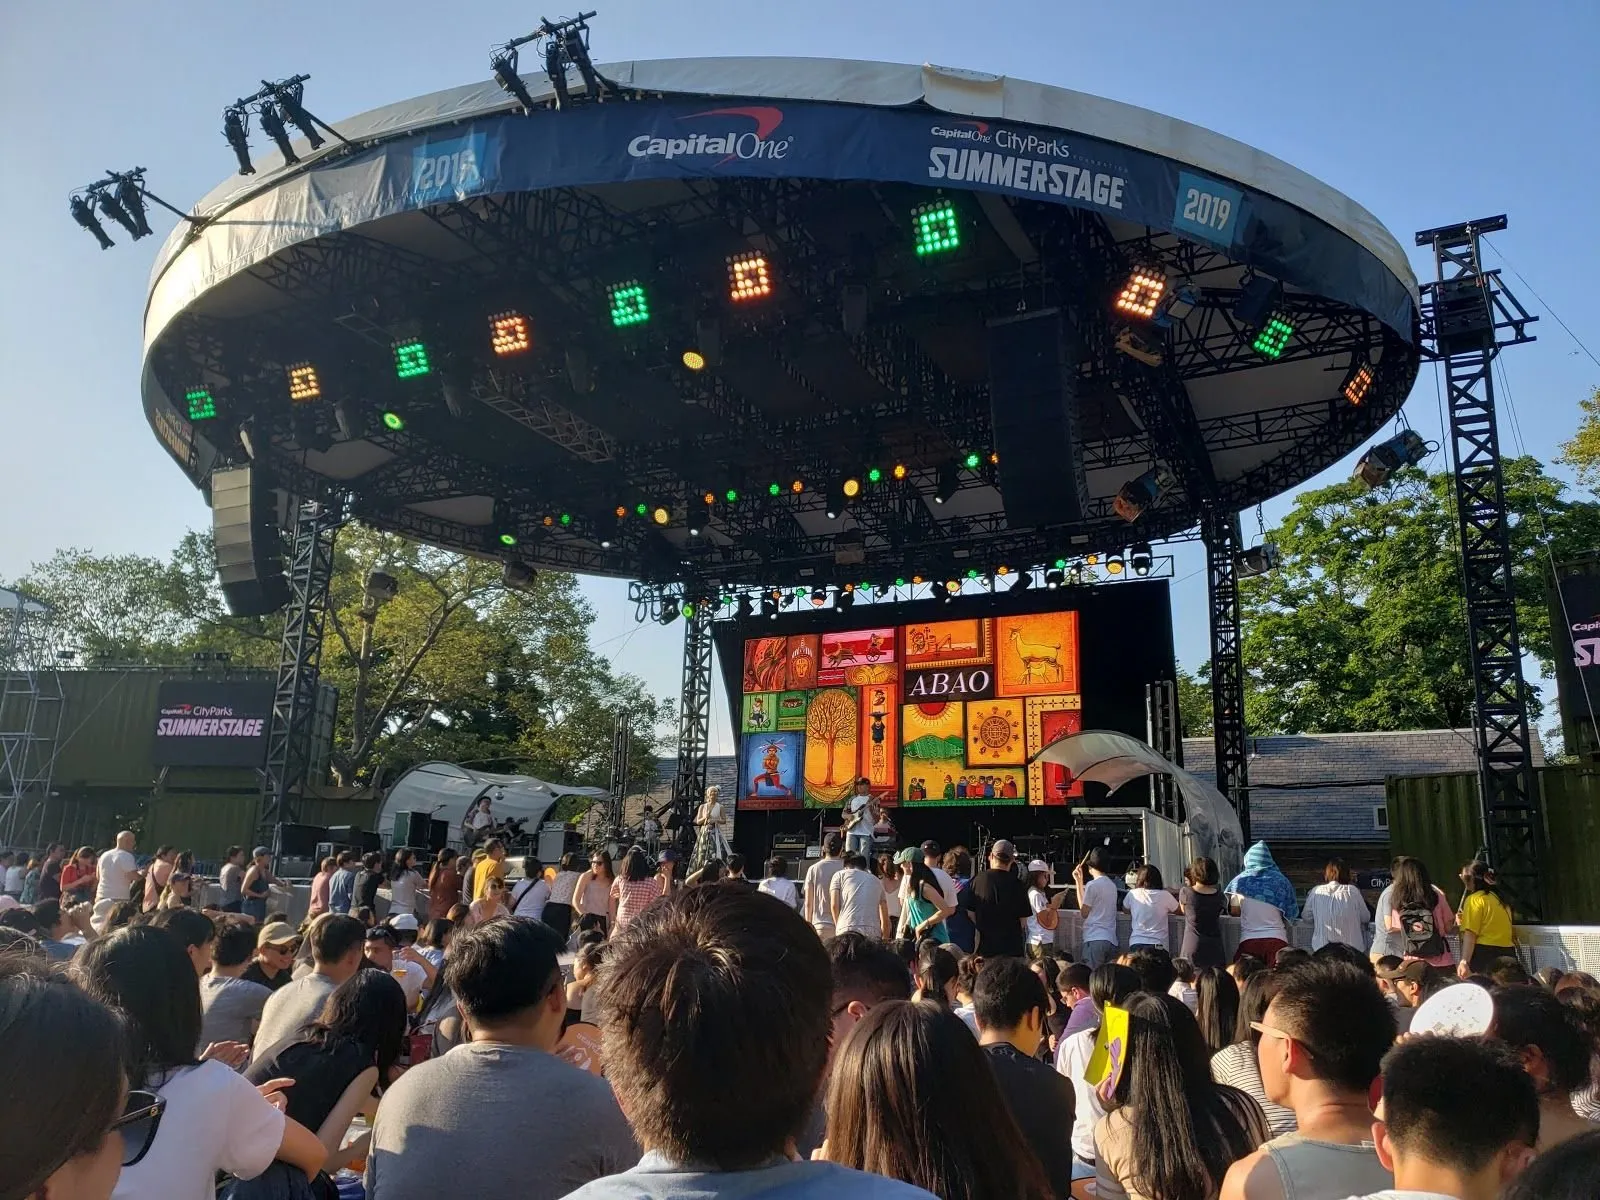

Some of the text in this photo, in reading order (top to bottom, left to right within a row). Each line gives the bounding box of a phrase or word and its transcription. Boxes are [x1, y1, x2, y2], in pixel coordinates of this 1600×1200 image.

[995, 129, 1070, 158] CityParks
[928, 146, 1125, 210] SUMMERSTAGE
[1183, 188, 1232, 232] 2019
[1571, 621, 1600, 632] Capi
[908, 670, 990, 697] ABAO
[193, 705, 233, 717] CityParks
[156, 718, 265, 737] SUMMERSTAGE
[1370, 878, 1391, 888] CityP
